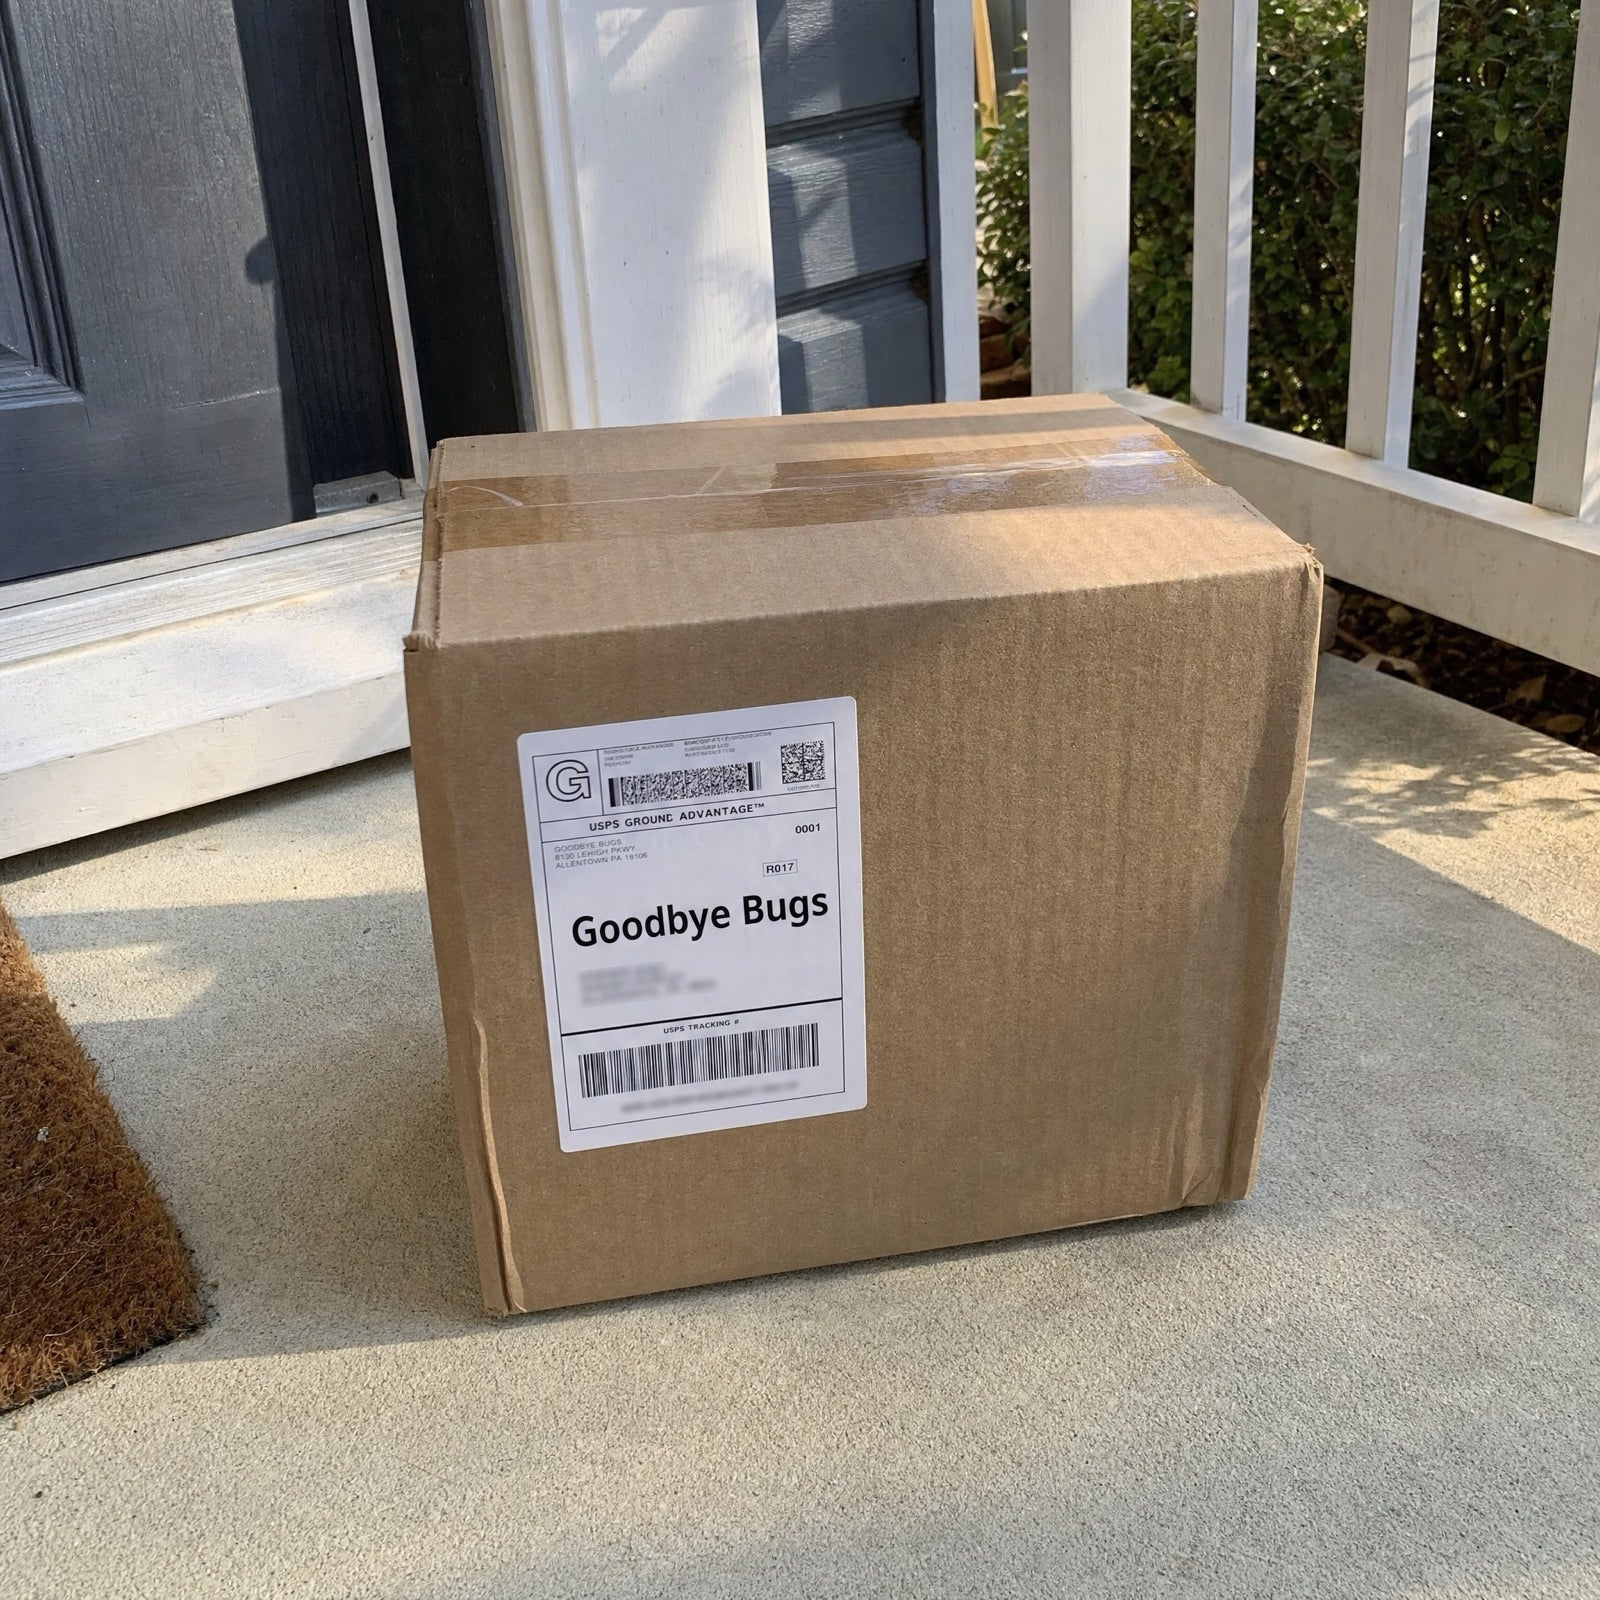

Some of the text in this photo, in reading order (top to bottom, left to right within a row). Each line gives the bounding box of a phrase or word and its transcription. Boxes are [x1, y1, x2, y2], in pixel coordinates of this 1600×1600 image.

[546, 759, 592, 803] G
[589, 819, 620, 831] USPS
[795, 823, 821, 834] 0001
[554, 839, 622, 853] GOODBYE BUGS
[577, 849, 609, 858] LEHIGH
[611, 845, 636, 854] PKWY
[555, 857, 608, 869] ALLENTOWN
[766, 863, 794, 874] R017
[572, 893, 829, 947] Goodbye Bugs
[663, 1026, 685, 1034] USPS
[688, 1020, 730, 1031] TRACKING
